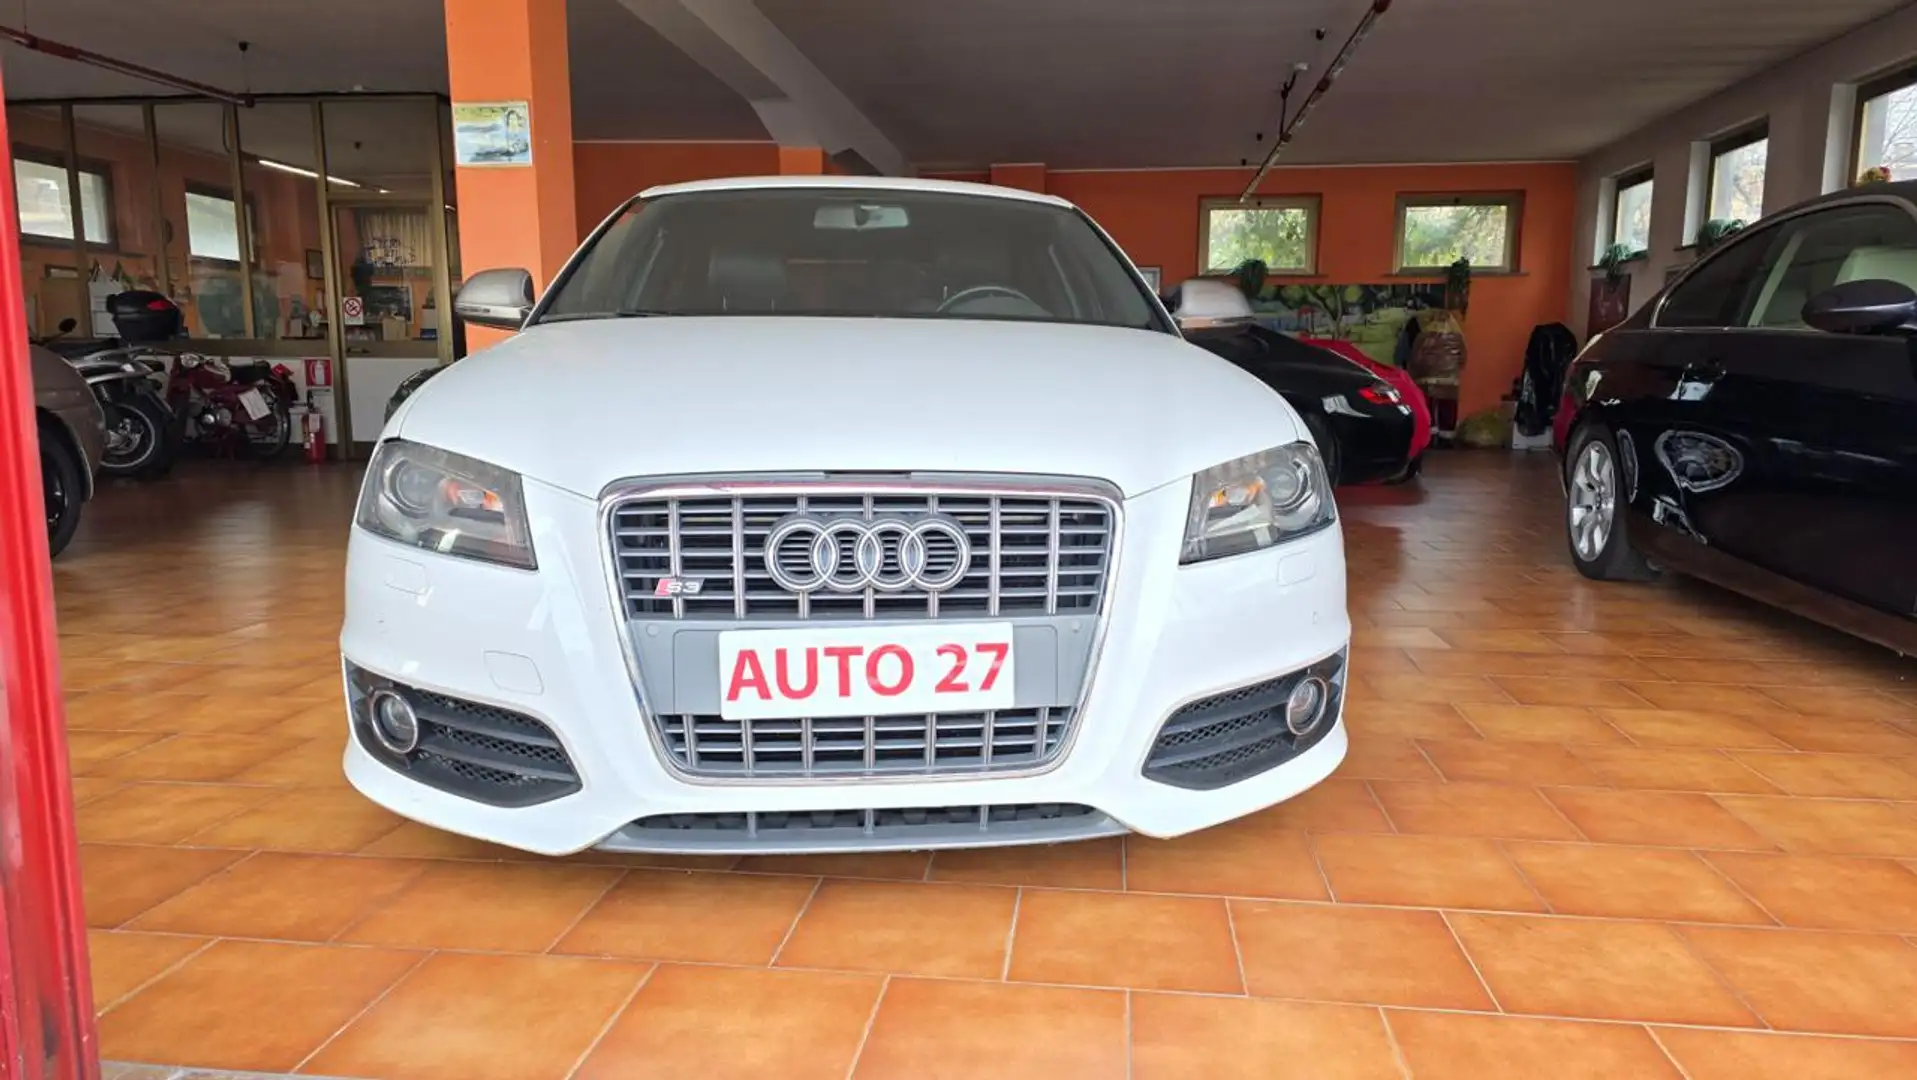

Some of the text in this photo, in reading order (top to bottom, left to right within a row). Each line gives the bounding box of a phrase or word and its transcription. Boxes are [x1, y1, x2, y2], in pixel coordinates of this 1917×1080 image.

[665, 580, 701, 595] S3
[727, 643, 1009, 700] AUTO 27
